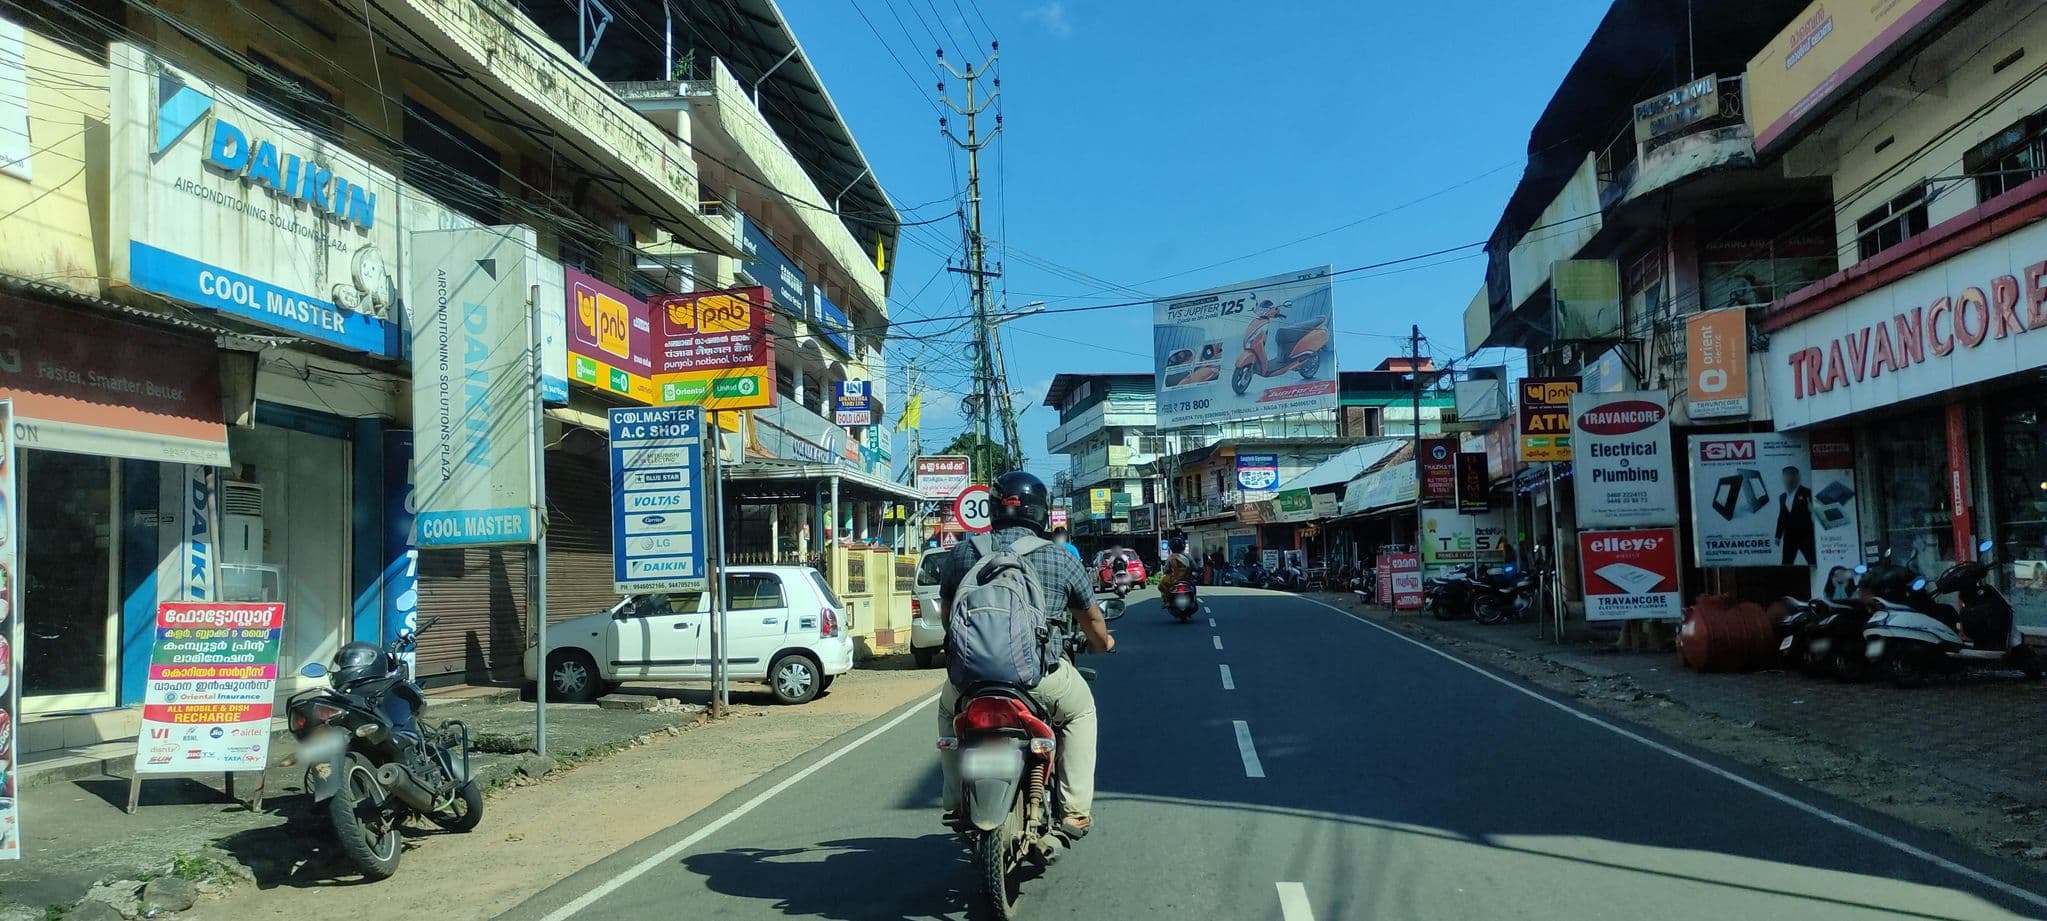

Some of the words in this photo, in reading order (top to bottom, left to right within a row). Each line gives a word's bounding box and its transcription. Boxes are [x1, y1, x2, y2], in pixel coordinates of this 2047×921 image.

[208, 118, 376, 231] DAIKIN
[174, 177, 267, 221] AIRCONDITIONING
[269, 213, 320, 242] SOLUTIONS
[199, 270, 261, 310] COOL
[266, 291, 346, 335] MASTER
[1168, 309, 1182, 320] TVS
[1183, 303, 1220, 316] JUPITER
[1220, 298, 1245, 316] 125
[437, 268, 451, 374] AIRCONDITIONING
[703, 302, 745, 328] pnb
[600, 309, 626, 343] pnb
[1788, 259, 2047, 400] TRAVANCORE
[1702, 324, 1713, 365] orient
[664, 358, 693, 371] punjab
[695, 355, 730, 366] national
[733, 353, 753, 363] bank
[38, 364, 86, 385] Faster.
[87, 370, 145, 395] Smarter.
[146, 380, 186, 401] Better.
[463, 302, 492, 468] DAIKIN
[675, 387, 705, 395] Oriental
[440, 374, 451, 442] SOLUTIONS
[1180, 401, 1191, 411] 78
[838, 413, 853, 424] GOLD
[854, 413, 869, 423] LOAN
[1584, 410, 1660, 425] TRAVANCORE
[621, 426, 645, 438] A.C
[650, 424, 690, 437] SHOP
[1591, 441, 1657, 457] Electrical
[1705, 442, 1753, 459] GM
[442, 444, 451, 482] PLAZA
[1593, 467, 1658, 483] Plumbing
[634, 495, 680, 507] VOLTAS
[964, 500, 990, 519] 30
[423, 518, 461, 538] COOL
[465, 514, 523, 536] MASTER
[191, 478, 208, 600] DAIKI
[656, 538, 671, 547] LG
[1706, 540, 1770, 549] TRAVANCORE
[643, 561, 686, 572] DAIKIN
[1598, 595, 1666, 605] TRAVANCORE
[173, 652, 255, 663] ലാമിനേഷൻ
[154, 682, 192, 691] വാഹന
[167, 705, 182, 713] ALL
[174, 712, 241, 723] RECHARGE
